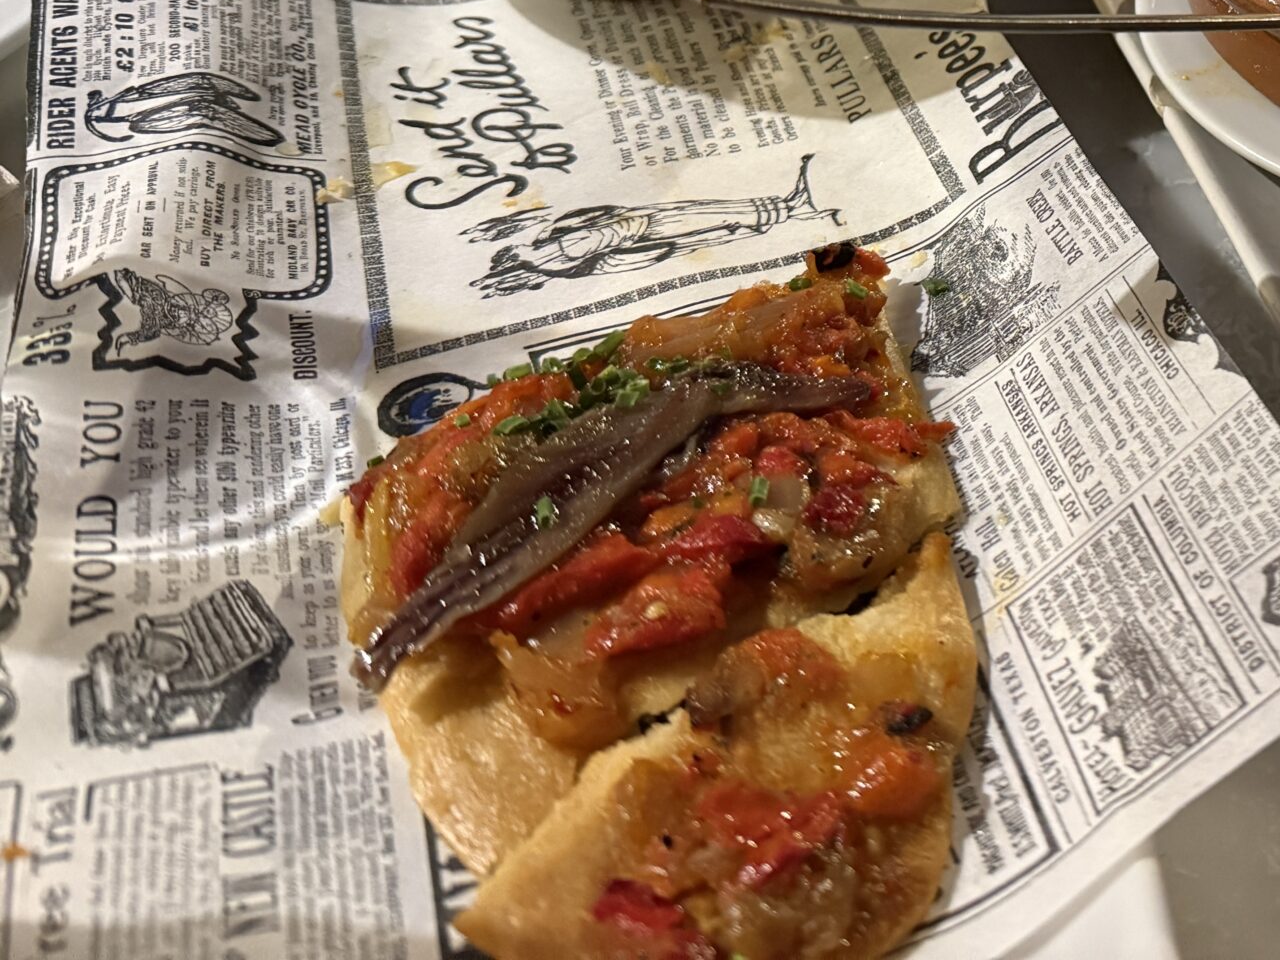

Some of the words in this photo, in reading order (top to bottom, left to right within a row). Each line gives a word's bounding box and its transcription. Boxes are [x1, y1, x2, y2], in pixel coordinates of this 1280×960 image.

[183, 0, 198, 10] to
[48, 25, 78, 88] AGENTS
[102, 34, 111, 53] made
[168, 42, 180, 61] 200
[102, 56, 111, 80] British
[450, 14, 563, 141] Pullars
[591, 67, 613, 99] Dinner
[612, 67, 634, 98] Dress
[808, 32, 873, 124] PULLARS
[291, 65, 308, 109] CYCLE
[395, 64, 453, 112] it
[623, 98, 642, 119] Ball
[640, 85, 664, 122] Cleaning
[666, 95, 682, 111] the
[703, 86, 728, 124] cleaned
[740, 96, 757, 118] Hose
[46, 97, 75, 149] RIDER
[294, 114, 312, 154] MEAD
[605, 108, 631, 145] Evening
[630, 118, 654, 151] Wrap,
[653, 124, 670, 141] the
[688, 97, 715, 141] material
[717, 126, 735, 140] be
[748, 117, 769, 148] Evening
[674, 112, 702, 161] garments
[702, 141, 721, 158] No
[724, 142, 742, 155] to
[404, 119, 530, 211] Send
[509, 141, 578, 175] to
[615, 145, 637, 170] Your
[643, 154, 657, 167] or
[660, 144, 679, 164] For
[104, 174, 120, 194] Easy
[176, 176, 186, 187] not
[189, 166, 200, 196] carriage.
[204, 160, 216, 188] FROM
[284, 181, 296, 195] CO.
[71, 180, 85, 224] Exceptional
[86, 192, 96, 212] Cash.
[115, 180, 130, 206] Prices.
[144, 200, 155, 210] ON
[188, 199, 199, 214] pay
[214, 180, 226, 224] MAKERS.
[286, 200, 296, 212] CAR
[1025, 187, 1056, 224] CREEK
[109, 207, 126, 243] Payment
[142, 216, 154, 236] SENT
[174, 200, 185, 232] returned
[184, 216, 194, 228] We
[202, 197, 213, 236] DIRECT
[286, 218, 297, 238] BABY
[140, 242, 151, 258] CAR
[168, 235, 182, 262] Money
[200, 246, 211, 266] BUY
[212, 231, 224, 251] THE
[1043, 218, 1083, 265] BATTLE
[288, 244, 298, 279] MIDLAND
[289, 309, 318, 380] DISCOUNT.
[1048, 326, 1066, 344] the
[1062, 315, 1086, 343] Perfect
[1057, 338, 1074, 354] by
[1110, 327, 1144, 370] EASTMAN
[1061, 350, 1098, 398] controlled
[1103, 350, 1125, 376] Write
[1014, 350, 1060, 417] ARKANSAS
[1057, 377, 1088, 413] pleasure
[167, 398, 187, 423] your
[244, 404, 262, 430] other
[268, 404, 280, 420] one
[286, 402, 300, 412] or
[962, 394, 983, 421] Table
[1000, 378, 1038, 438] ARKANSAS
[1088, 394, 1108, 416] and
[1110, 397, 1139, 432] States
[1140, 375, 1187, 438] ARLINGTON
[79, 399, 124, 468] YOU
[134, 417, 158, 448] grade
[164, 427, 180, 440] to
[190, 410, 210, 456] wherein
[218, 400, 240, 455] typewriter
[266, 422, 282, 444] have
[286, 416, 301, 436] card
[1085, 425, 1110, 456] health
[1097, 412, 1129, 452] Owned
[288, 440, 303, 460] post
[986, 444, 1010, 476] always
[999, 429, 1031, 484] unsurpassed.
[1047, 411, 1094, 480] SPRINGS,
[1130, 429, 1161, 468] United
[1203, 430, 1236, 471] Running
[128, 456, 153, 481] high
[162, 446, 186, 504] typewriter
[196, 456, 208, 477] see
[288, 466, 305, 478] by
[1101, 454, 1133, 494] Greatest
[192, 478, 209, 504] them
[220, 486, 238, 514] other
[268, 473, 286, 500] could
[288, 484, 306, 510] Then
[1083, 480, 1113, 514] HOT
[1016, 503, 1040, 536] always
[1023, 482, 1054, 533] attendance
[1057, 491, 1084, 522] HOT
[971, 516, 1001, 551] Hall.
[1151, 493, 1198, 565] COLUMBIA
[1238, 515, 1267, 551] Union
[68, 494, 118, 627] WOULD
[1201, 525, 1241, 575] HOTEL
[987, 548, 1021, 590] Galen
[1192, 566, 1214, 589] OF
[1033, 586, 1060, 627] TEXAS
[1207, 592, 1266, 672] DISTRICT
[994, 651, 1026, 705] TEXAS
[1045, 657, 1098, 734] GALVEZ
[29, 786, 79, 876] Trial
[36, 884, 71, 954] ree
